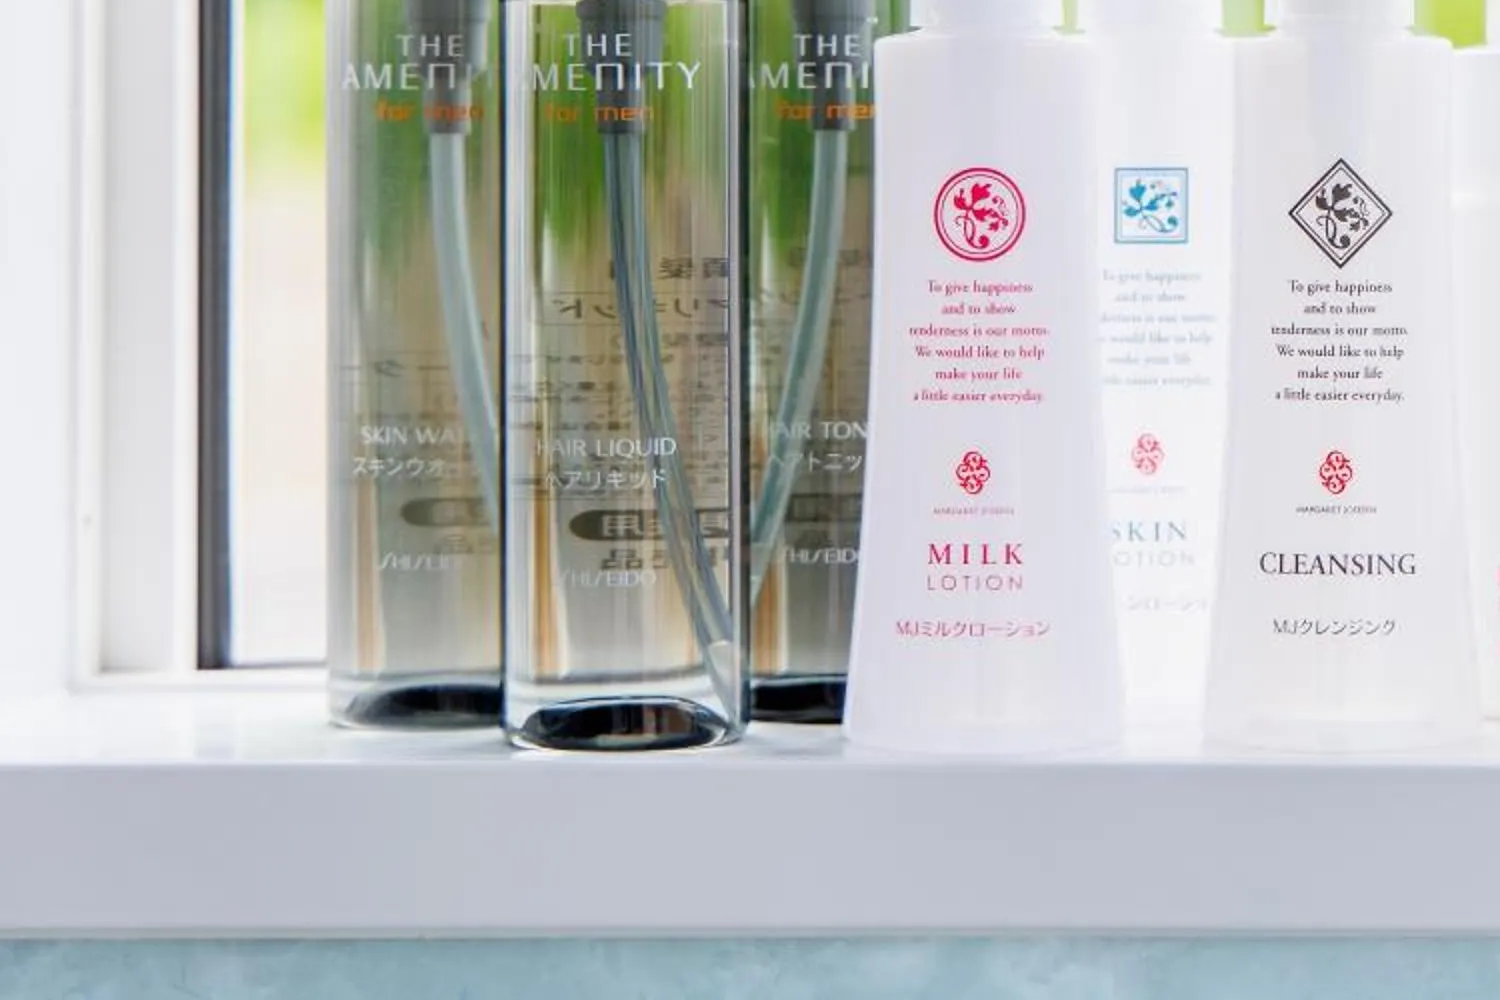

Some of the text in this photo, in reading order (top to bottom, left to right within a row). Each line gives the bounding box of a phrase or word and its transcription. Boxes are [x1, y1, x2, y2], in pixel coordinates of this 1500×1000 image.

[396, 34, 464, 57] THE
[564, 33, 633, 57] THE
[793, 34, 862, 57] THE
[376, 98, 484, 121] for men
[545, 103, 654, 122] for men
[776, 99, 814, 119] for
[928, 279, 1033, 297] To give happiness
[1288, 279, 1393, 297] To give happiness
[941, 301, 1016, 315] and to show
[1303, 301, 1376, 315] and to show
[909, 323, 969, 337] tenderness
[973, 323, 983, 336] is
[986, 327, 1008, 337] our
[1271, 322, 1331, 336] tenderness
[1335, 323, 1344, 336] is
[1347, 327, 1368, 336] our
[914, 345, 1045, 361] We would like to help
[1275, 344, 1405, 361] We would like to help
[935, 366, 1022, 382] make your life
[1297, 365, 1383, 383] make your life
[913, 393, 919, 401] a
[921, 388, 948, 401] little
[951, 389, 986, 401] easier
[1275, 392, 1281, 401] a
[1284, 387, 1311, 401] little
[1314, 388, 1347, 401] easier
[360, 424, 457, 444] SKIN WA
[820, 421, 868, 439] TON
[537, 437, 677, 457] HAIR LIQUID
[544, 468, 668, 489] ヘアリキッド
[927, 542, 1024, 566] MILK
[1113, 549, 1196, 569] OTION
[1259, 551, 1417, 576] CLEANSING
[926, 573, 1024, 593] LOTION
[896, 618, 1051, 639] MJミルクローション
[1273, 616, 1397, 638] MJクレンジング
